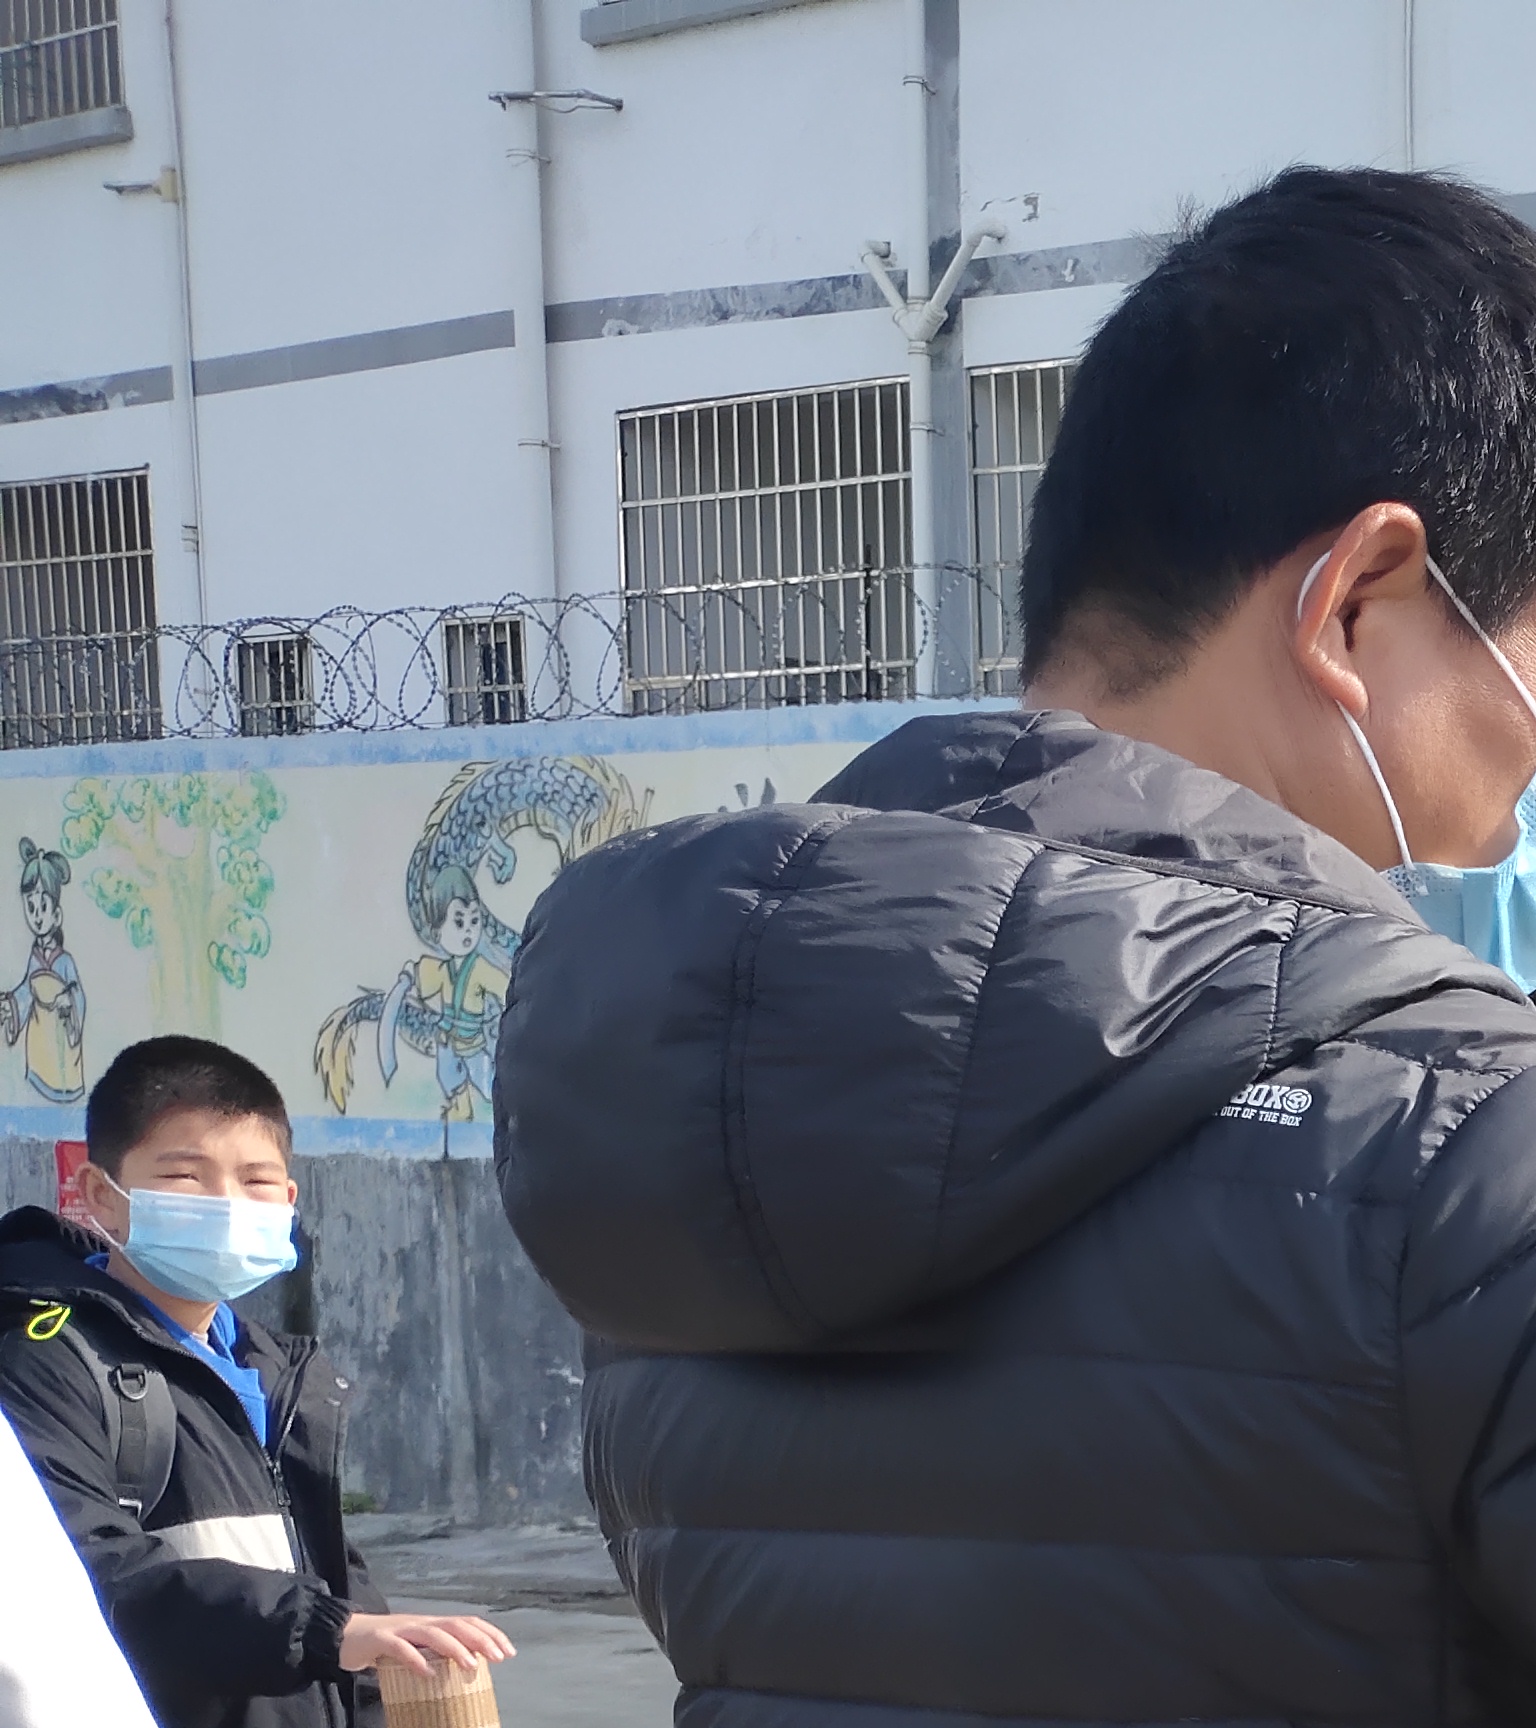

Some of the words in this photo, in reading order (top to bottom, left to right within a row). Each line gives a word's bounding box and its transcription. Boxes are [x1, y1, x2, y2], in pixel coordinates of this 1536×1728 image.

[1220, 1106, 1240, 1117] OUT
[1242, 1107, 1257, 1119] OF
[1258, 1110, 1279, 1123] THE
[1280, 1114, 1303, 1127] BOX
